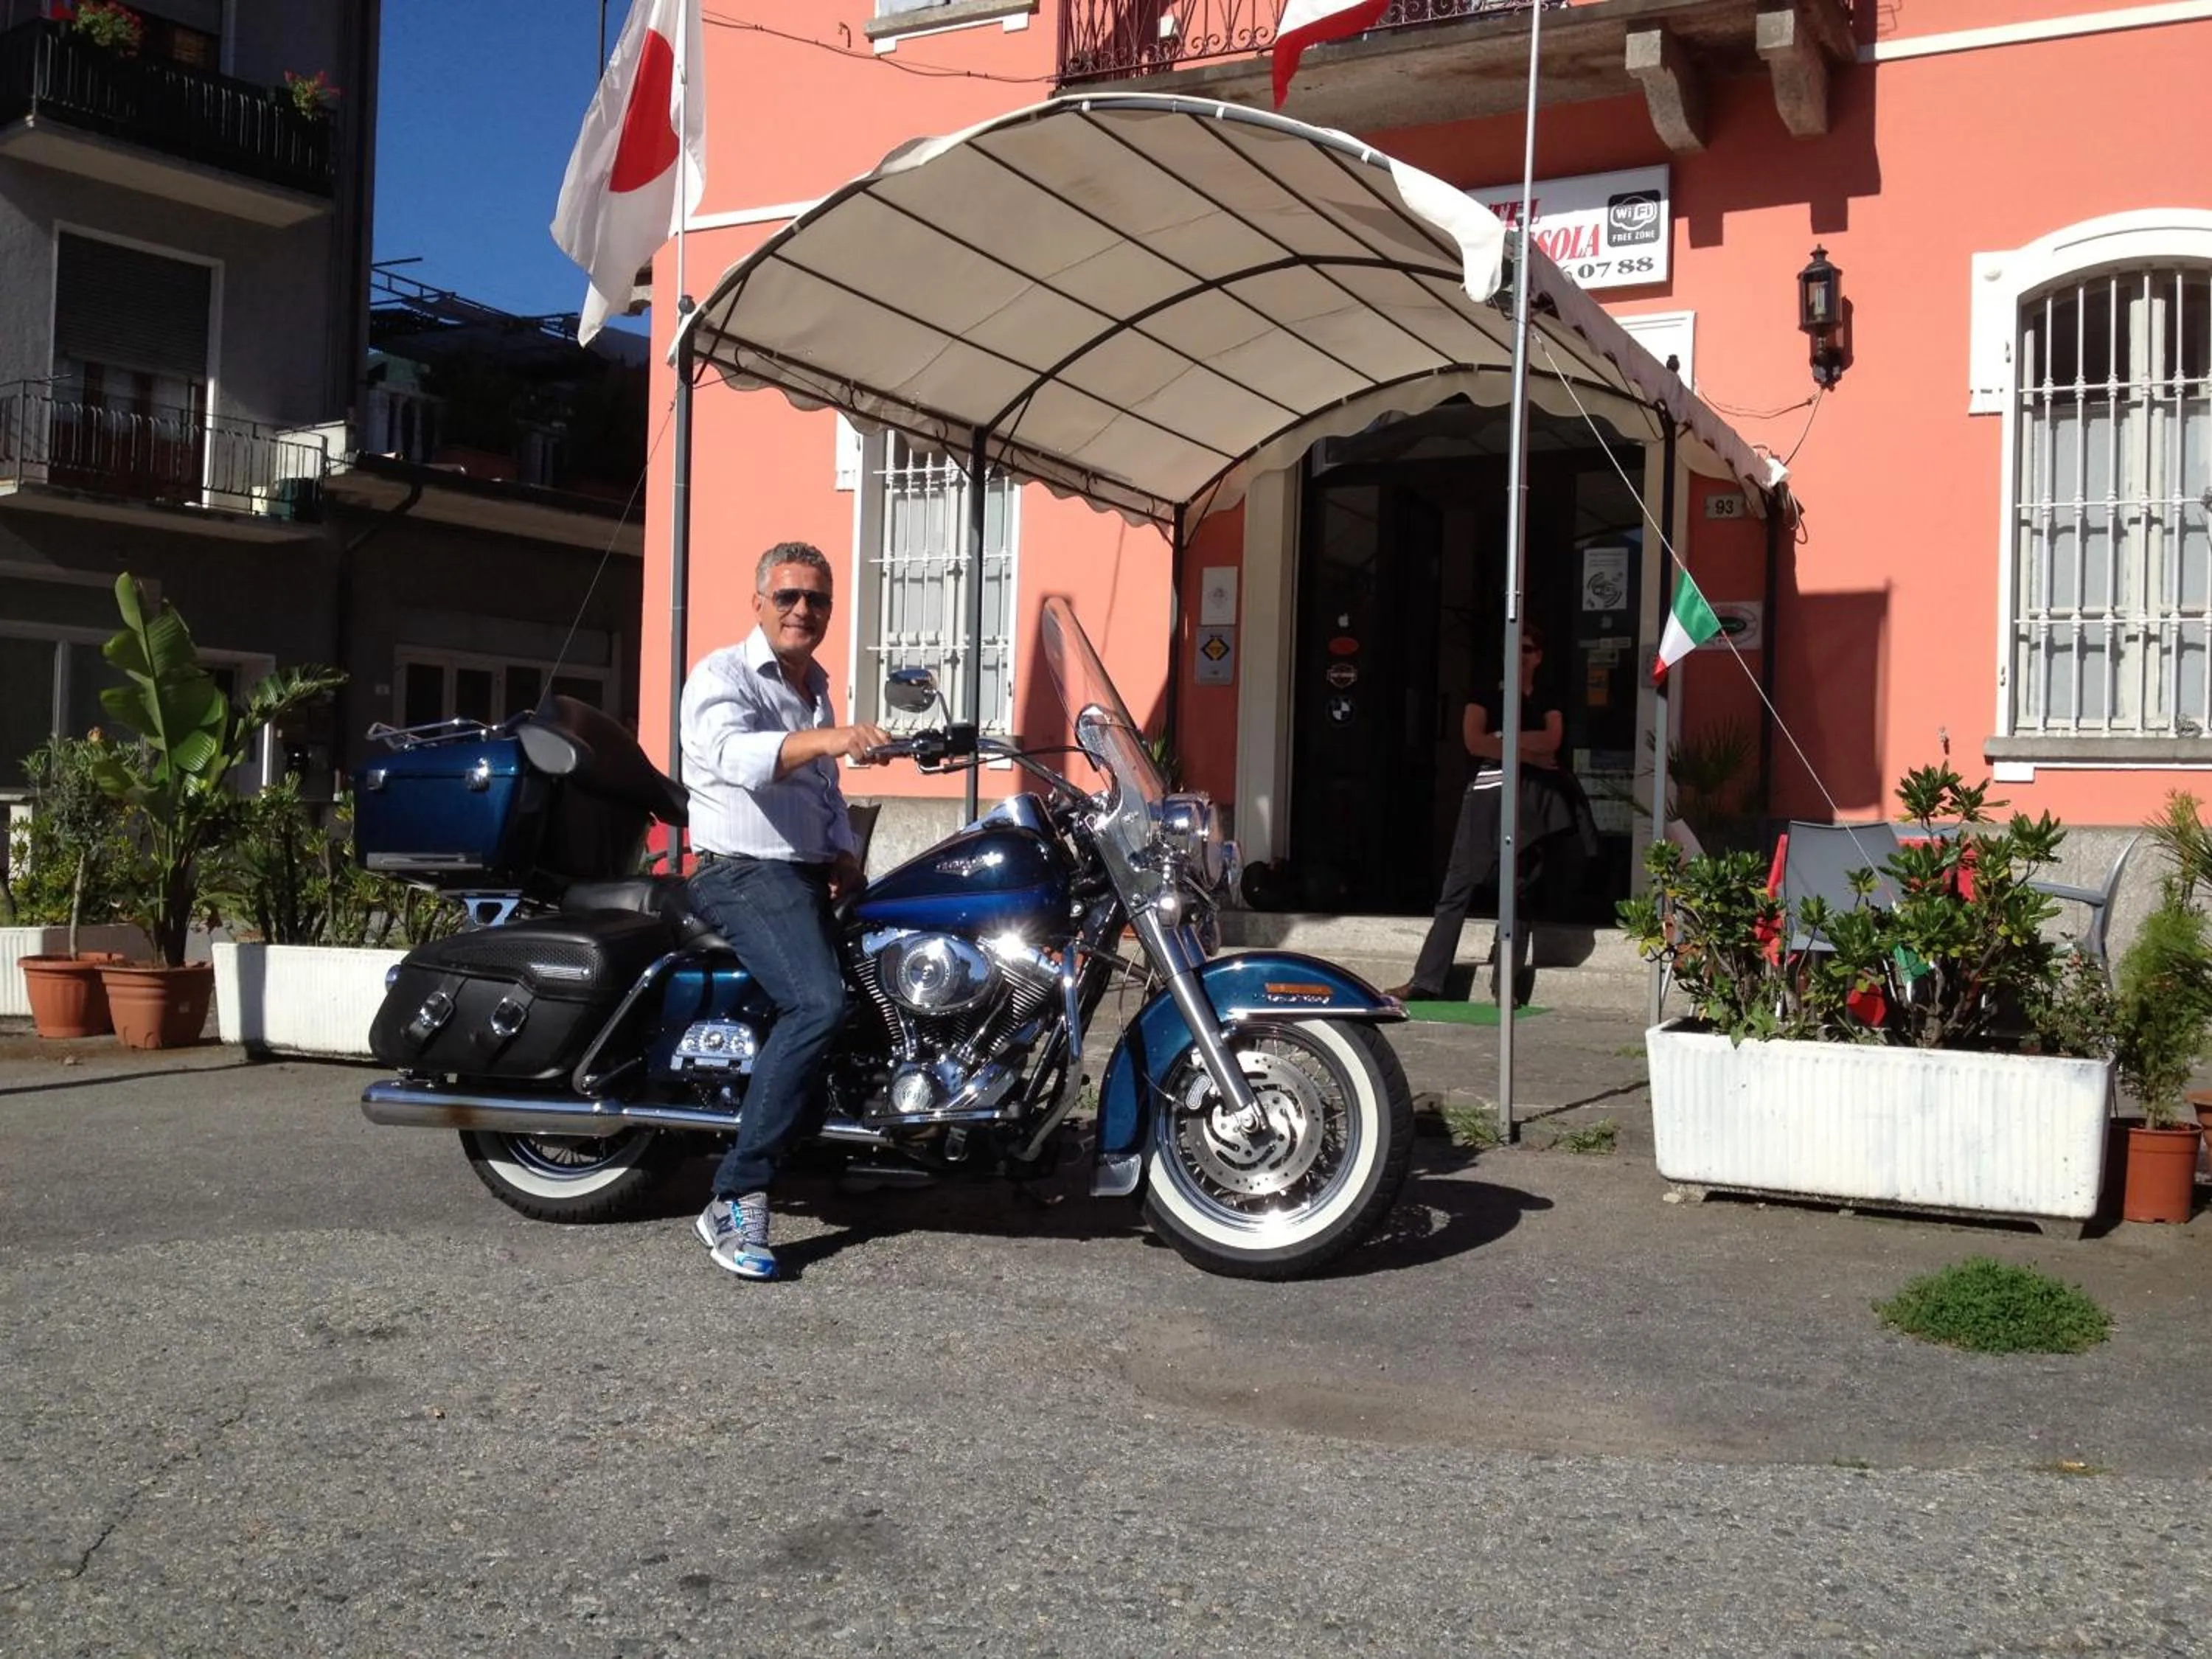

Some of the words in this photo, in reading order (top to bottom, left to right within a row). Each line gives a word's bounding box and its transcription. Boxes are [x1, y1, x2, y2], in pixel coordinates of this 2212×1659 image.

[1528, 223, 1599, 261] SOLA
[1612, 232, 1632, 243] FREE
[1635, 230, 1655, 240] ZONE
[1715, 499, 1734, 515] 93
